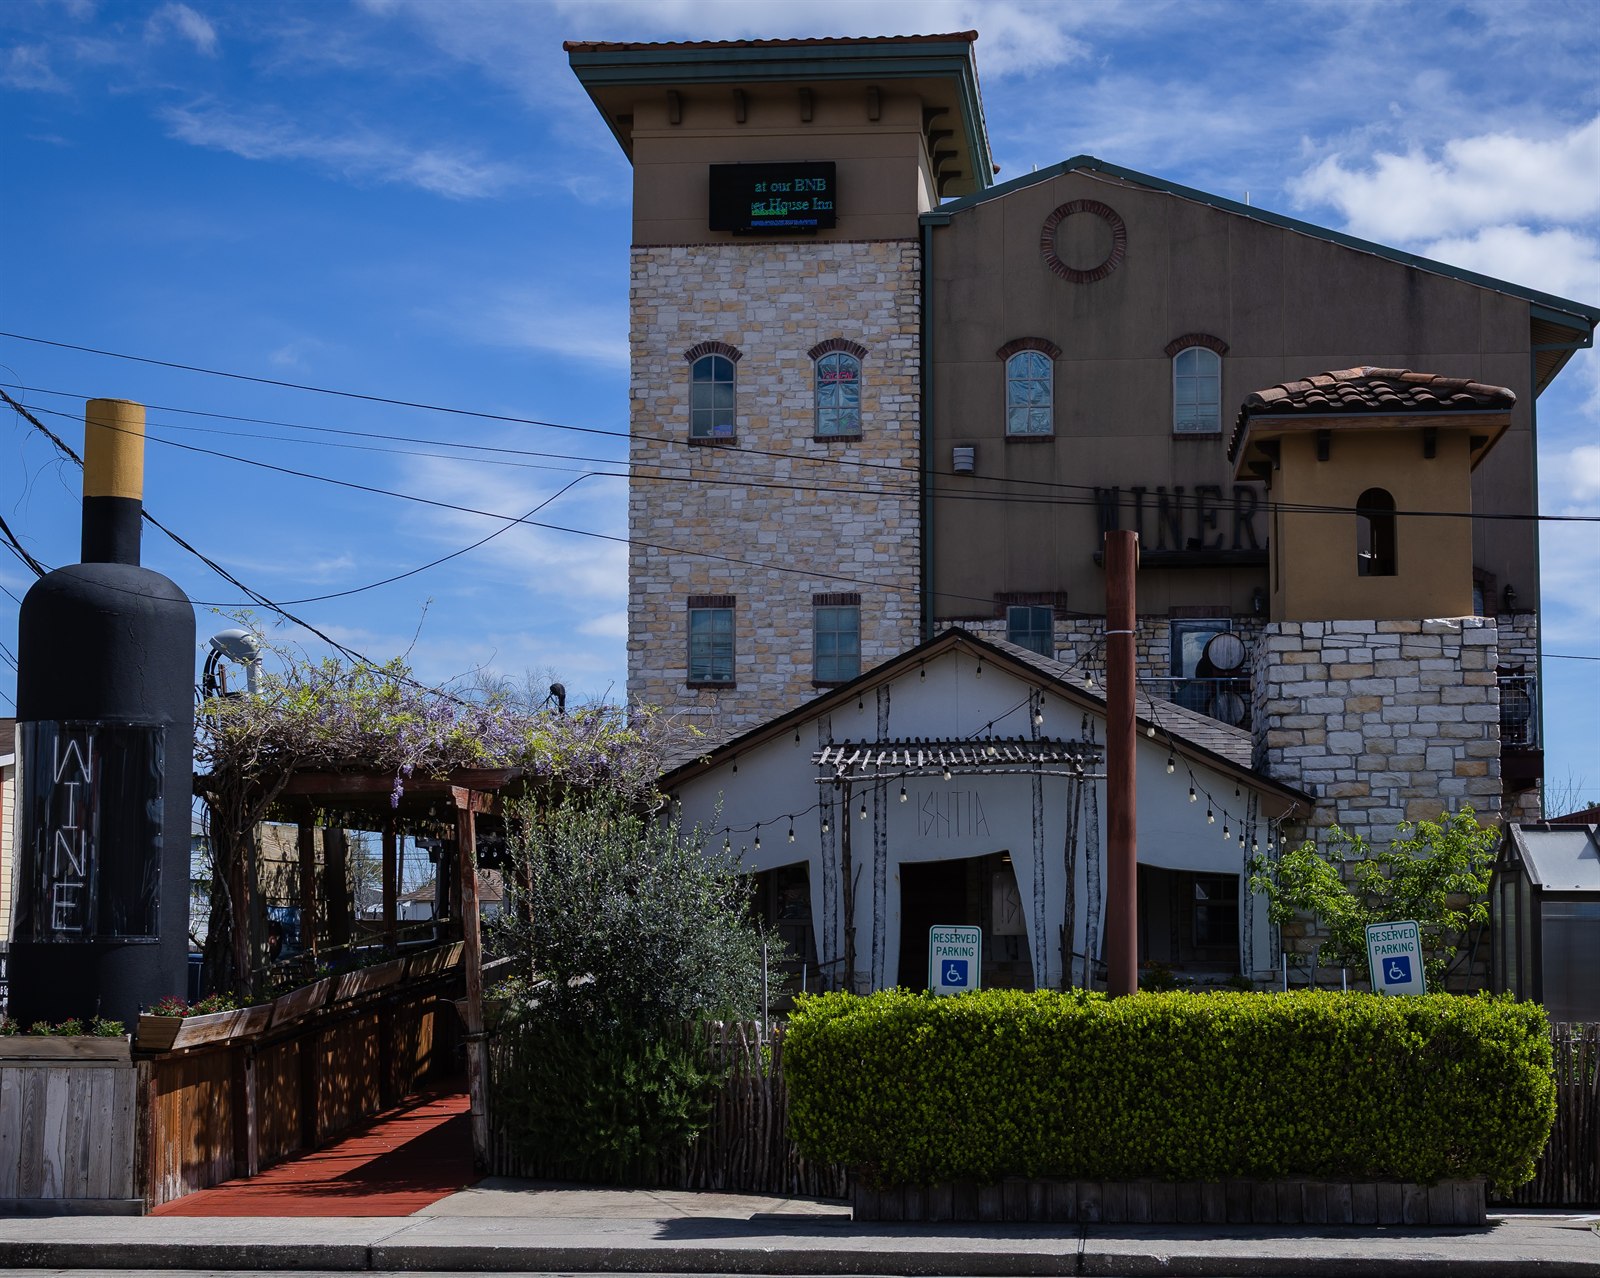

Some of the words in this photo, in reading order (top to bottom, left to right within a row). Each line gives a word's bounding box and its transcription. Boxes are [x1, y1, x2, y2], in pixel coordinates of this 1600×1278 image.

[754, 180, 768, 193] at
[769, 182, 792, 193] our
[794, 178, 827, 192] BNB
[769, 197, 810, 211] House
[811, 196, 833, 210] Inn
[51, 735, 93, 931] WINE
[933, 933, 978, 944] RESERVED
[1370, 928, 1415, 942] RESERVED
[936, 946, 974, 957] PARKING
[1374, 942, 1414, 955] PARKING
